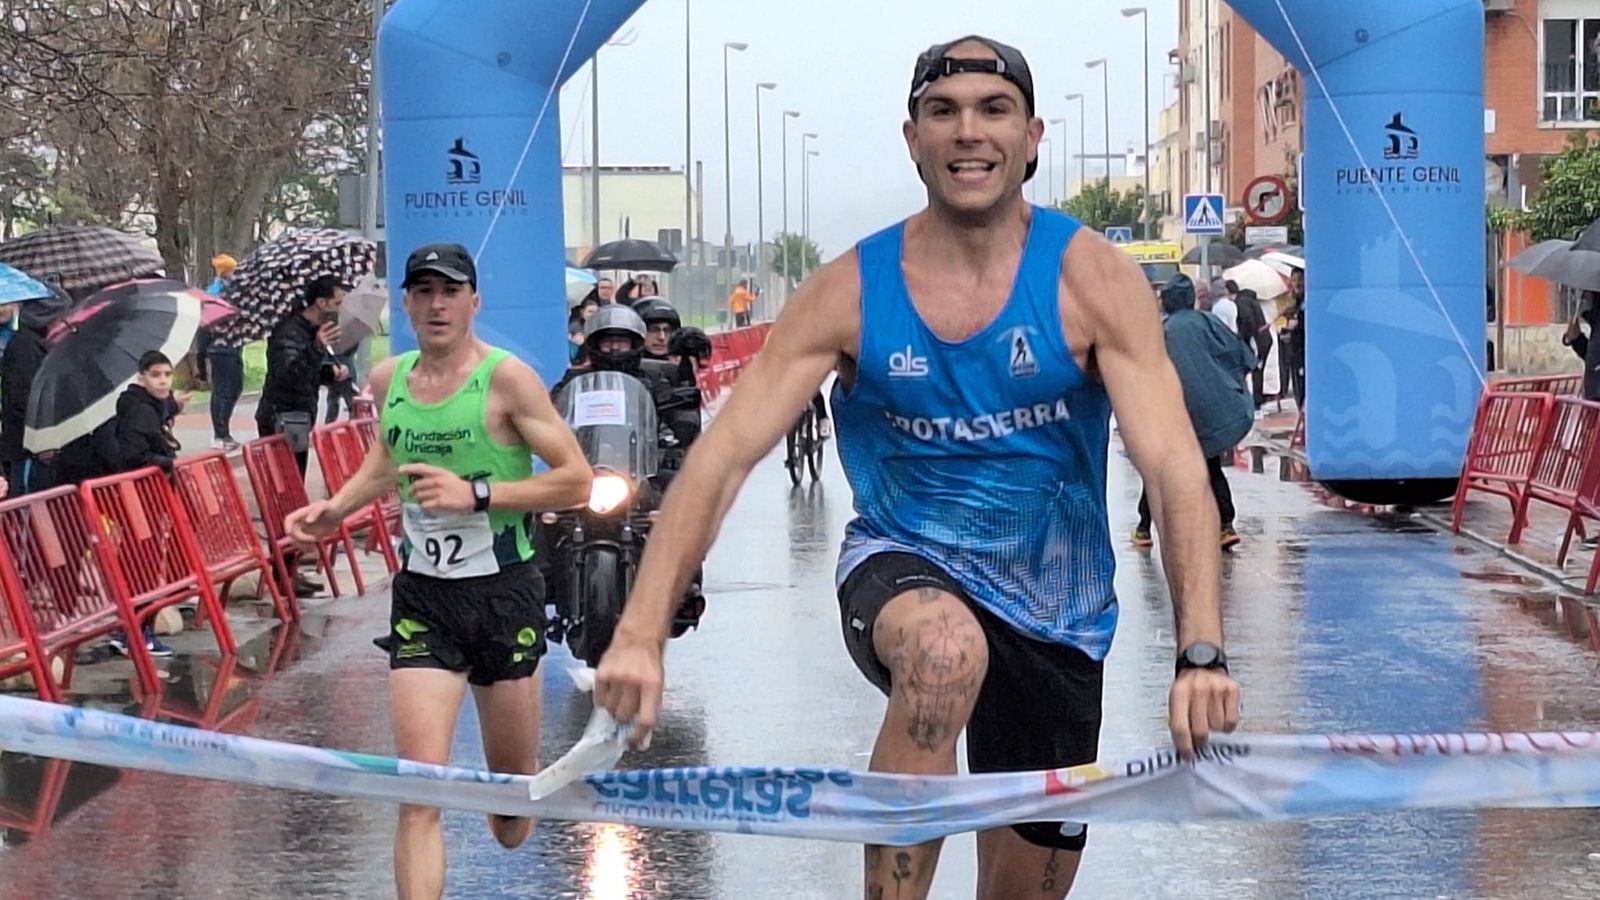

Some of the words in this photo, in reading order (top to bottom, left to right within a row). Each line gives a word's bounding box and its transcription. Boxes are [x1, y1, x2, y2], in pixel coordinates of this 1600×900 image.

[1337, 166, 1407, 184] PUENTE
[1413, 166, 1461, 183] GENIL
[404, 191, 469, 208] PUENTE
[476, 189, 528, 206] GENIL
[888, 344, 928, 375] als
[405, 428, 471, 441] Fundación
[425, 534, 466, 567] 92
